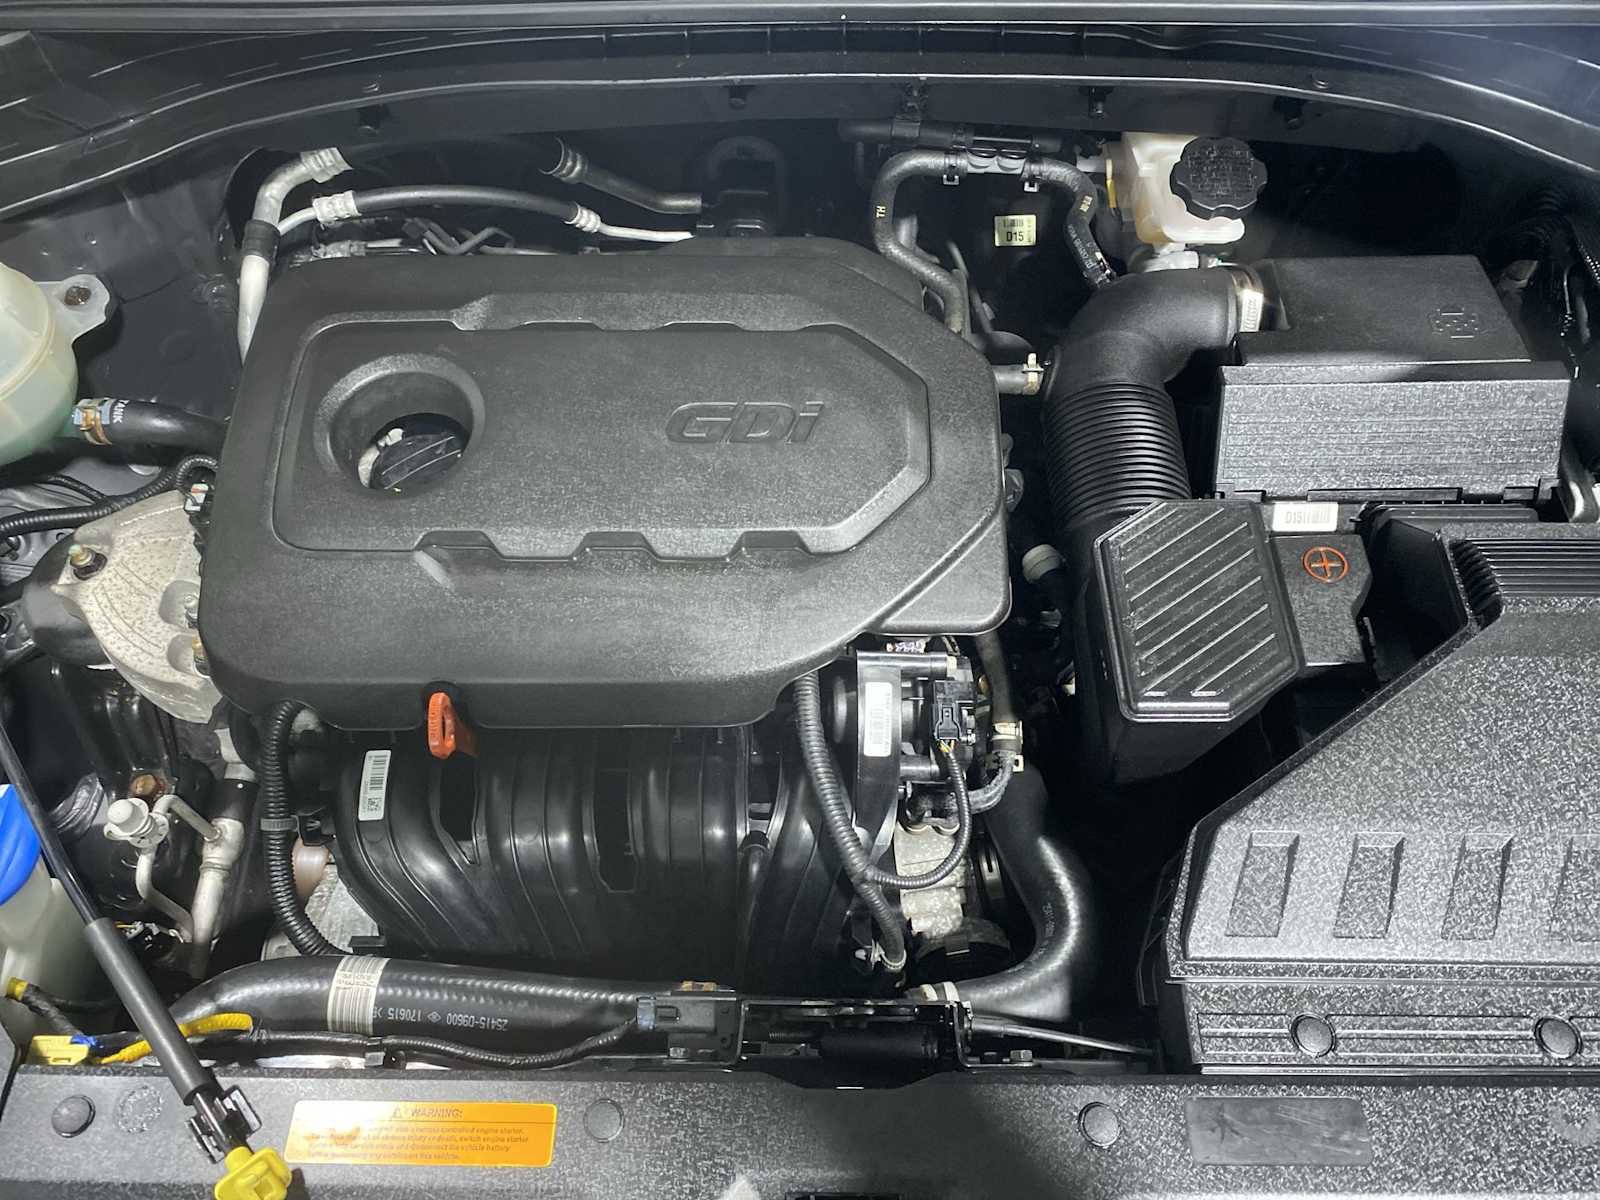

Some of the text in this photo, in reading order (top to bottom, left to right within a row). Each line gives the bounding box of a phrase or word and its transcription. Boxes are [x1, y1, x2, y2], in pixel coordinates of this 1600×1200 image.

[1006, 231, 1024, 242] D15
[387, 1006, 421, 1022] 170615
[446, 1012, 508, 1031] 25415-D9600
